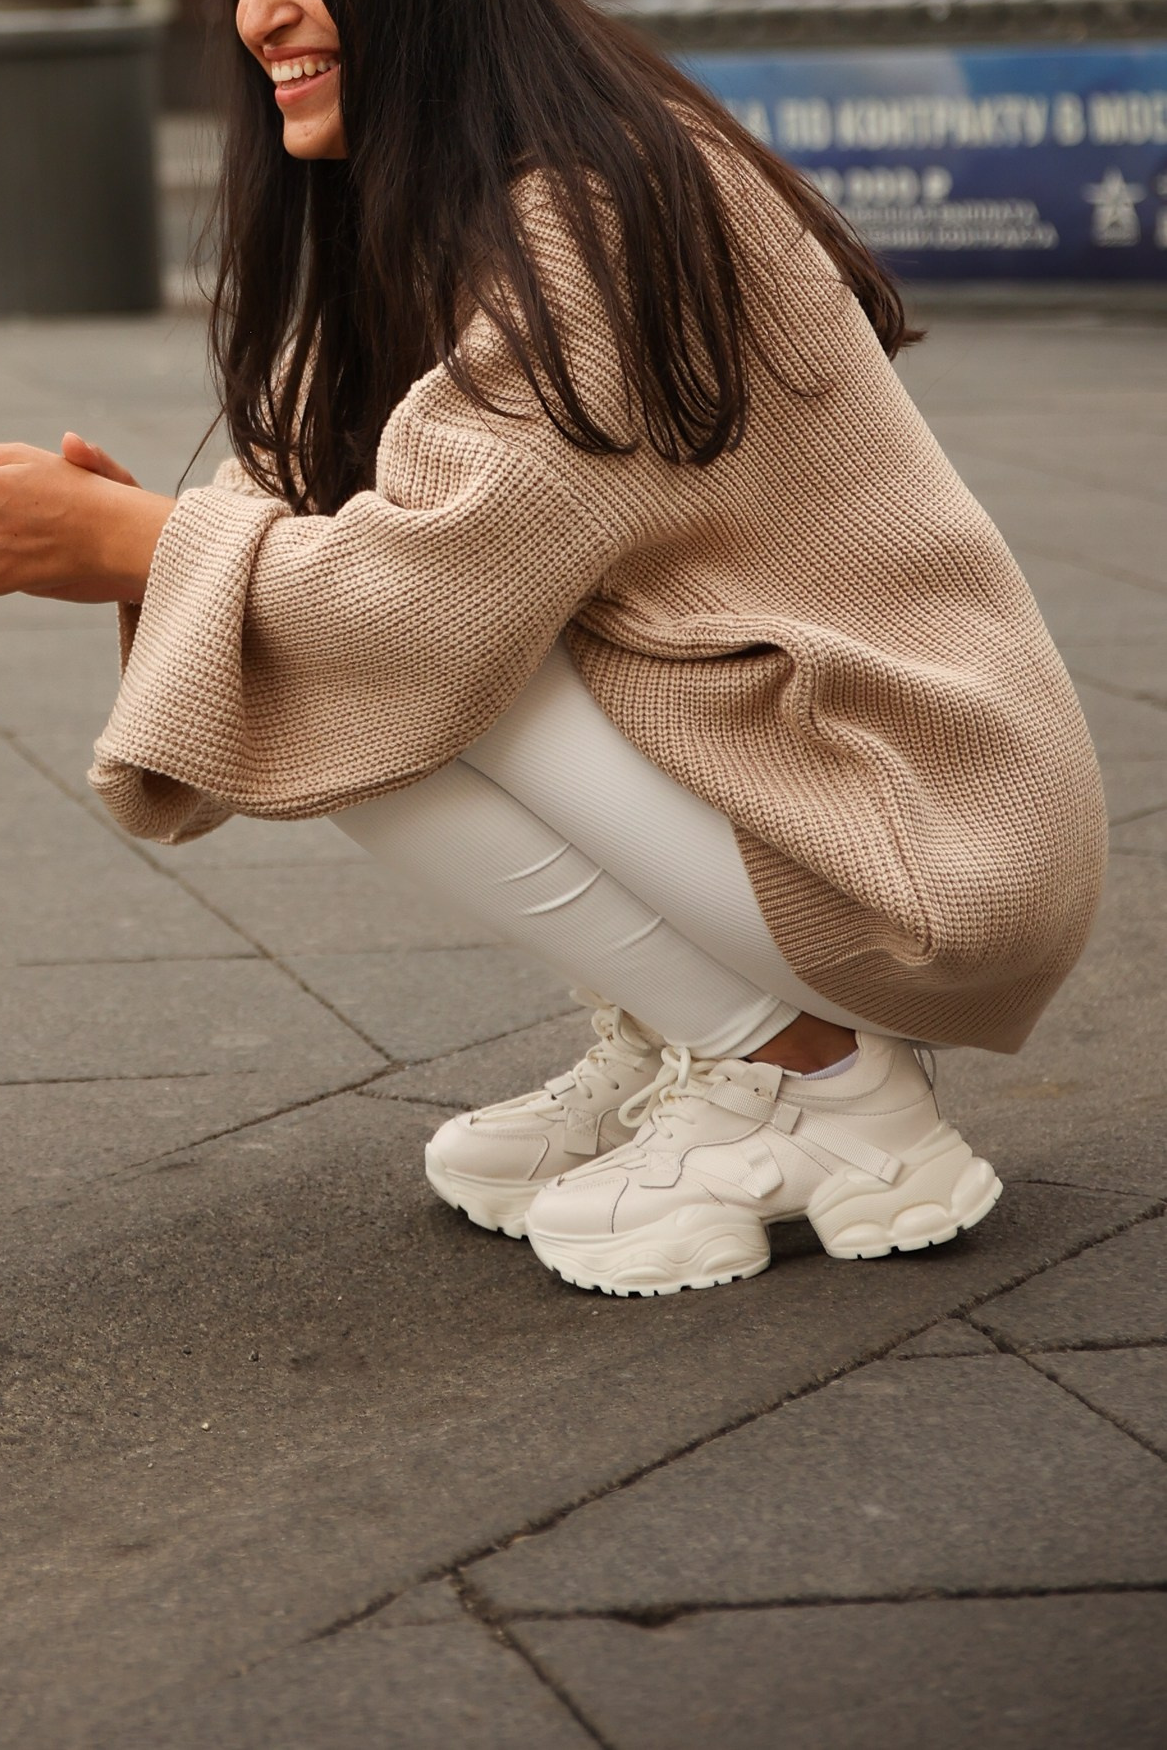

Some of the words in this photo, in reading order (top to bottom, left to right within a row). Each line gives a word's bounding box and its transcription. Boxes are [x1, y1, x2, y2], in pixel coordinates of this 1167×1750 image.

[780, 100, 828, 148] ПО
[839, 98, 1046, 146] КОНТРАКТУ
[1055, 96, 1082, 142] В
